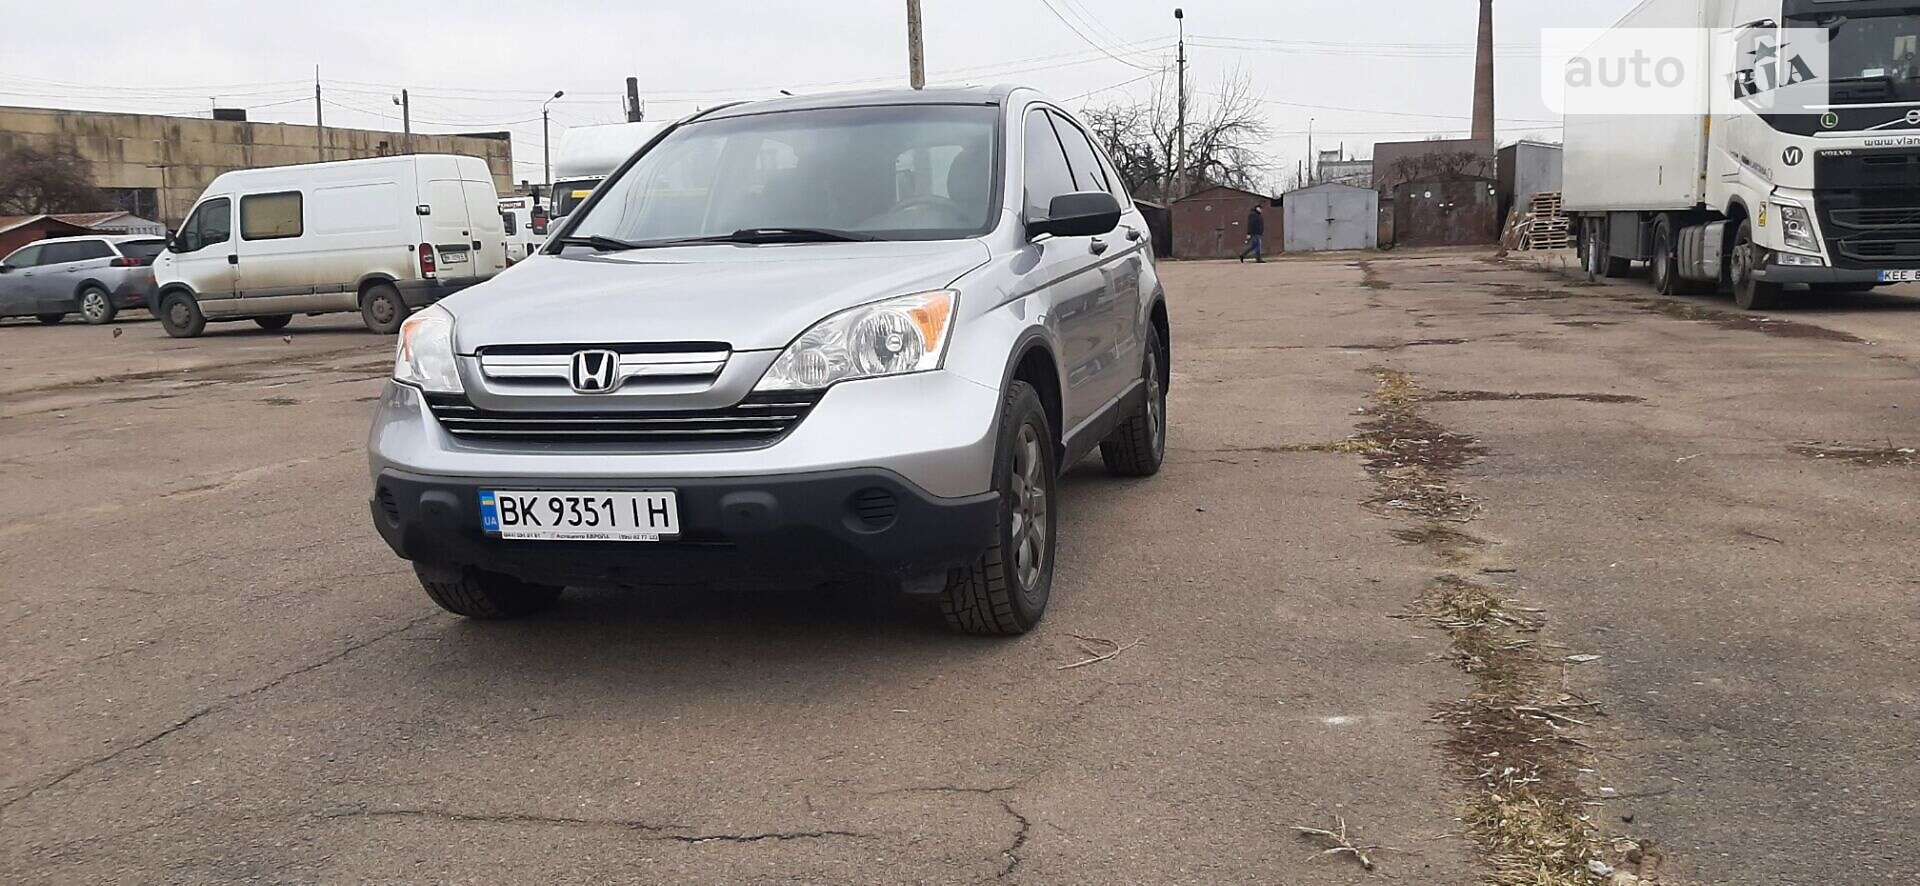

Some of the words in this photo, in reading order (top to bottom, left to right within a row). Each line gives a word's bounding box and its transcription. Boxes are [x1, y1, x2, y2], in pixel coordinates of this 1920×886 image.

[1785, 149, 1799, 164] VI
[1884, 271, 1908, 280] KEE
[499, 496, 542, 527] BK
[548, 497, 616, 527] 9351
[484, 516, 498, 526] UA
